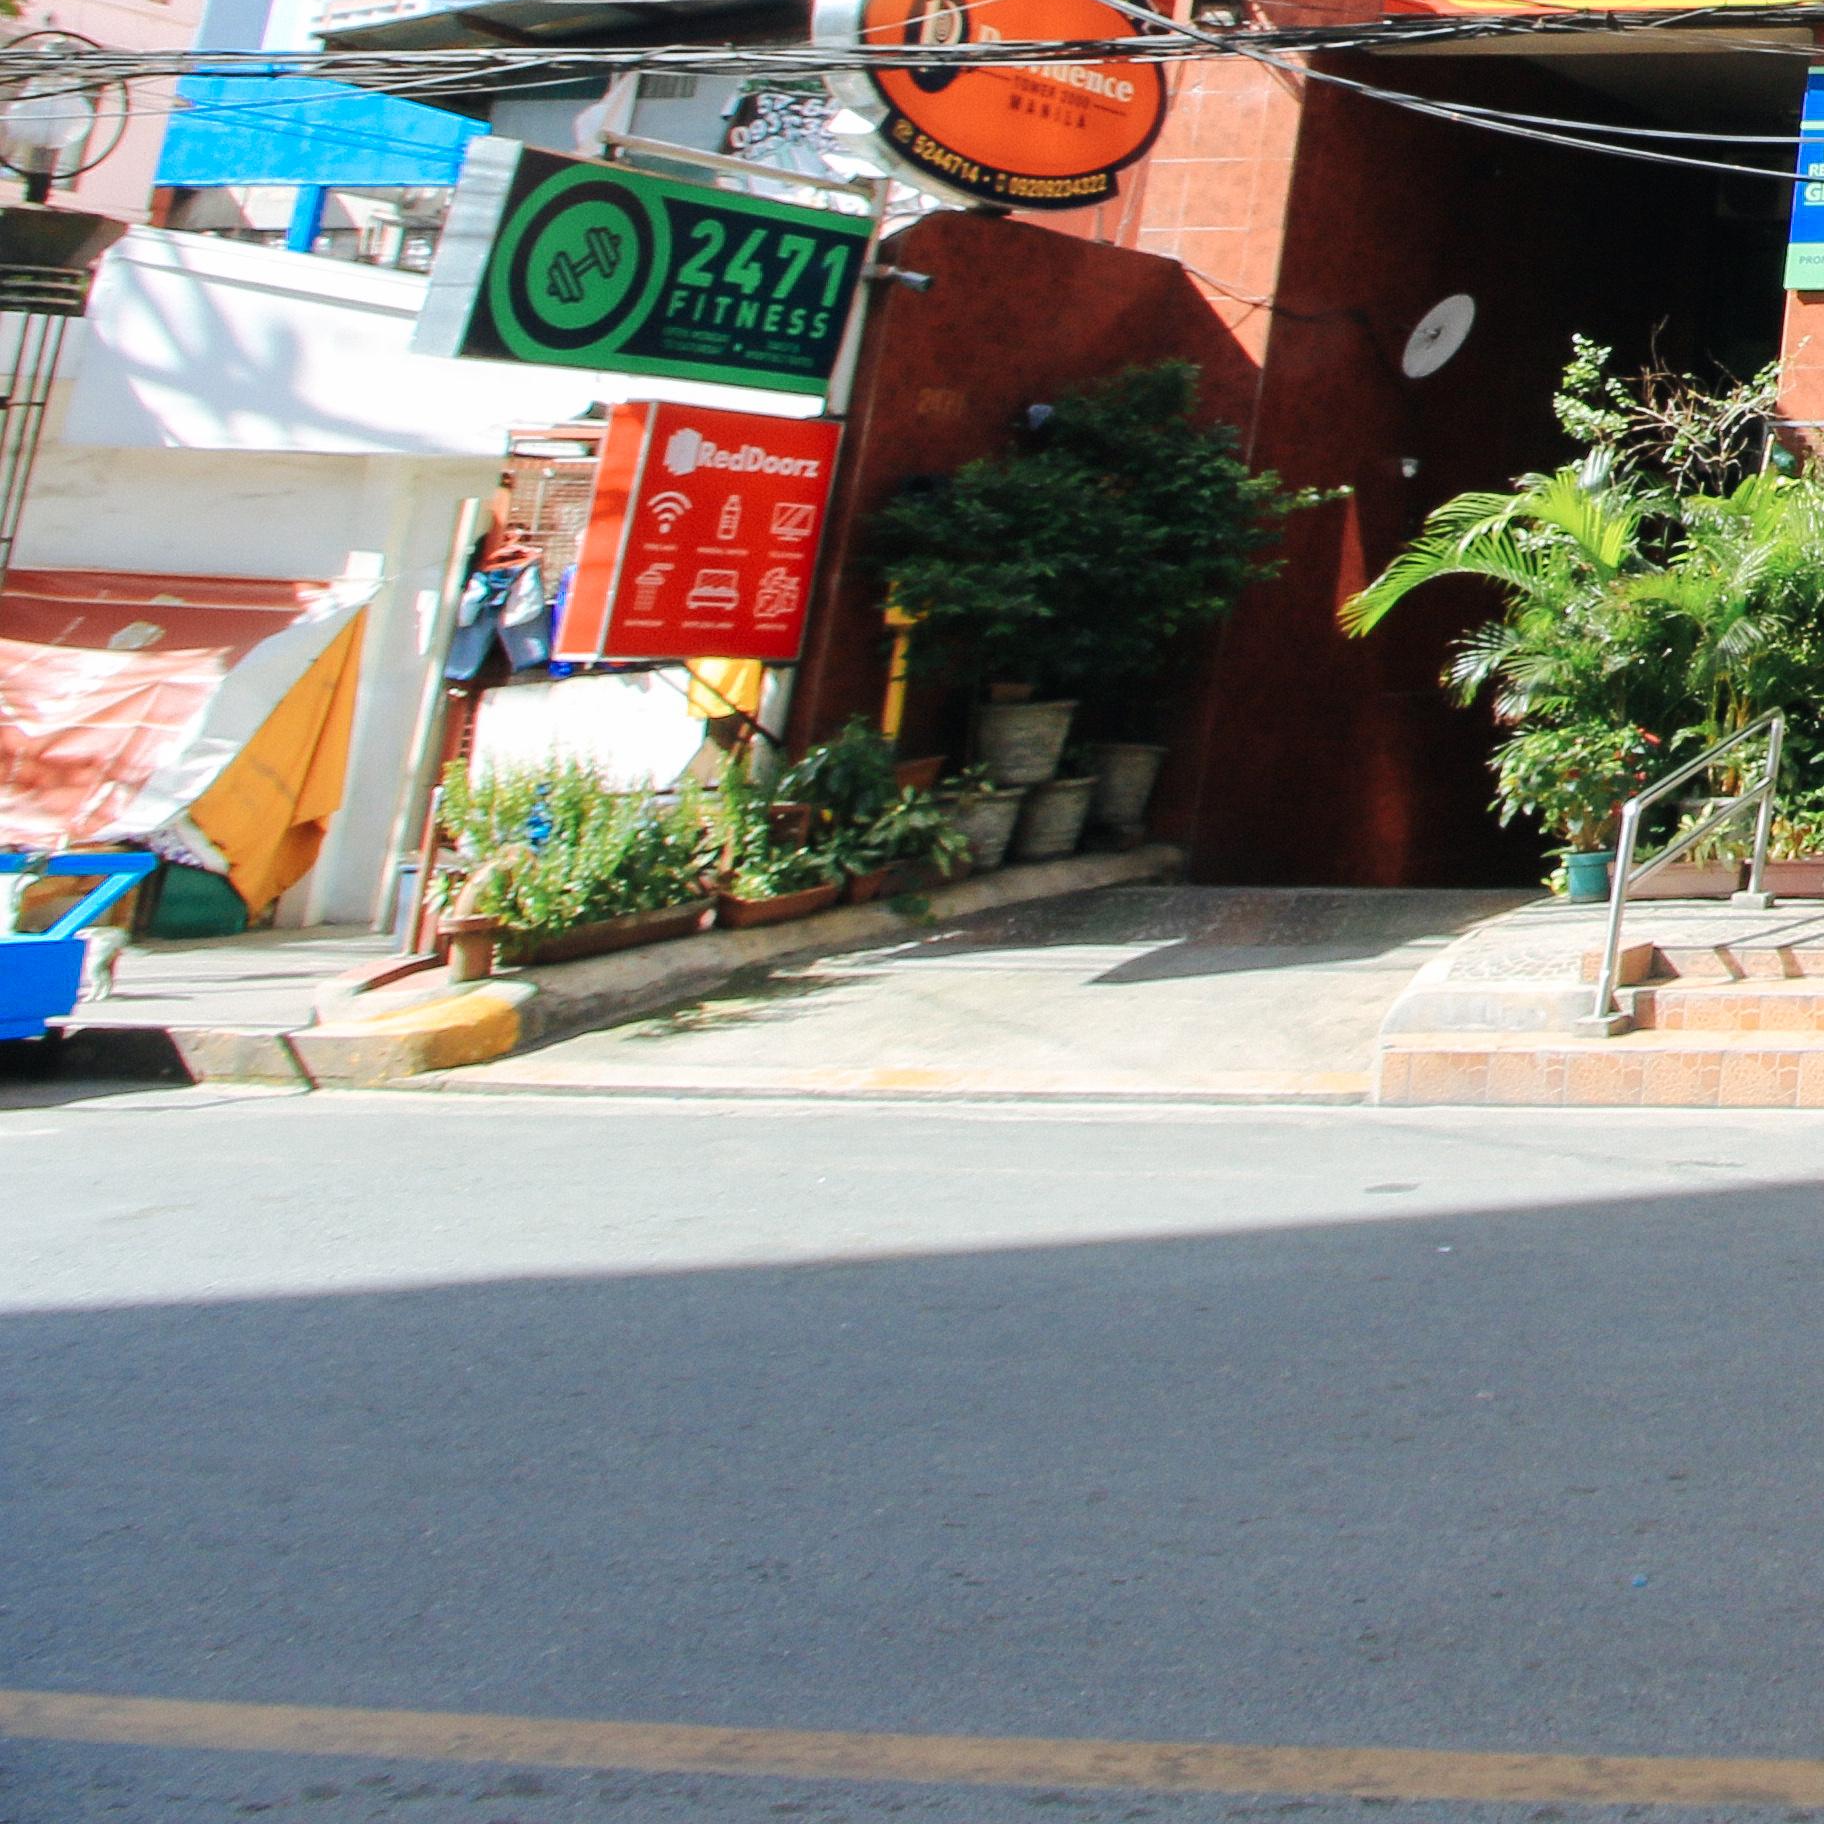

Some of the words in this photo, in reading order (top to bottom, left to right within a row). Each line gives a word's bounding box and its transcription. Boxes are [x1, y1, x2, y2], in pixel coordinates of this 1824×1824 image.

[1008, 94, 1087, 128] MANILA
[677, 218, 849, 309] 2471
[664, 289, 832, 339] FITNESS
[698, 440, 821, 479] RedDoorz
